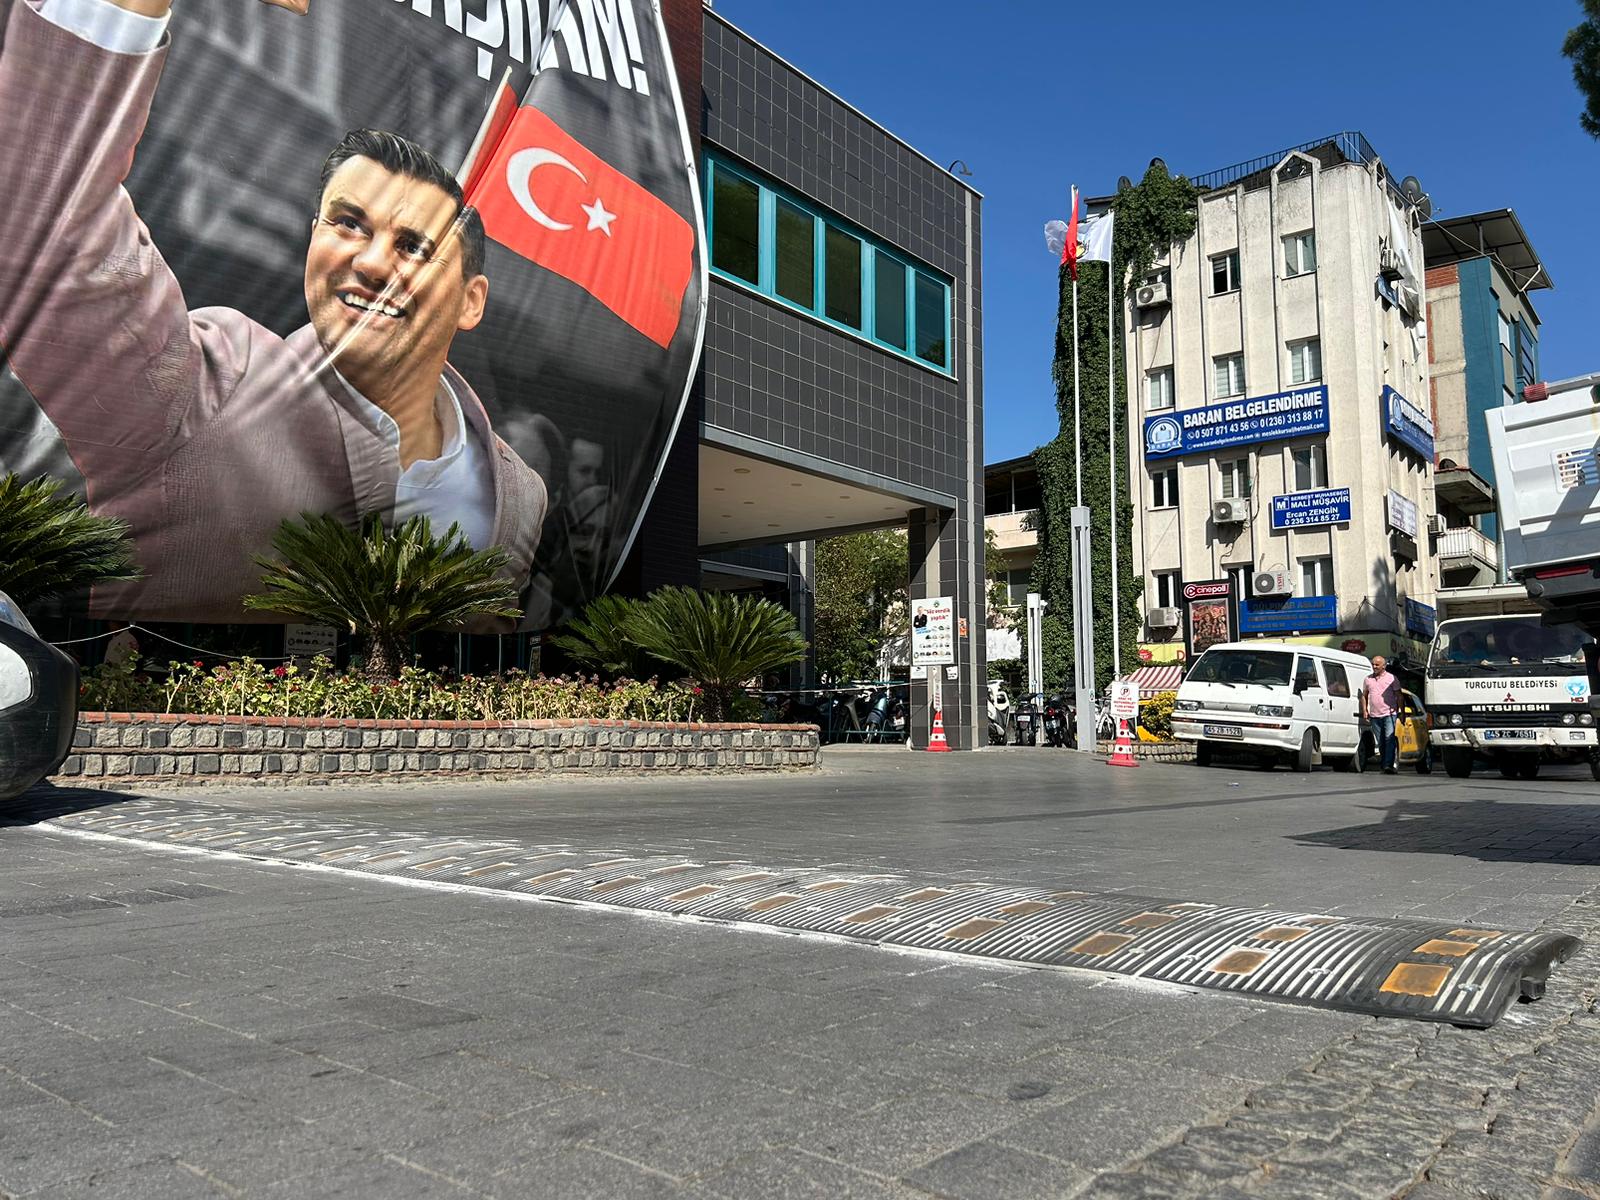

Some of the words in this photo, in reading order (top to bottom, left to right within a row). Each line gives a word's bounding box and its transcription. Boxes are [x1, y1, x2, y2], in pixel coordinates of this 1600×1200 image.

[1183, 408, 1223, 429] BARAN
[1225, 391, 1323, 421] BELGELENDİRME
[1195, 430, 1199, 439] 0
[1201, 427, 1213, 438] 507
[1215, 425, 1228, 436] 871
[1229, 423, 1239, 433] 43
[1240, 421, 1249, 431] 56
[1287, 413, 1301, 423] 313
[1302, 411, 1312, 421] 88
[1314, 409, 1324, 419] 17
[1312, 494, 1349, 506] MÜŞAVİR
[1286, 511, 1307, 519] Ercan
[1308, 506, 1339, 516] ZENGİN
[1464, 681, 1507, 689] TURGUTLU
[1471, 704, 1550, 712] MITSUBISHI
